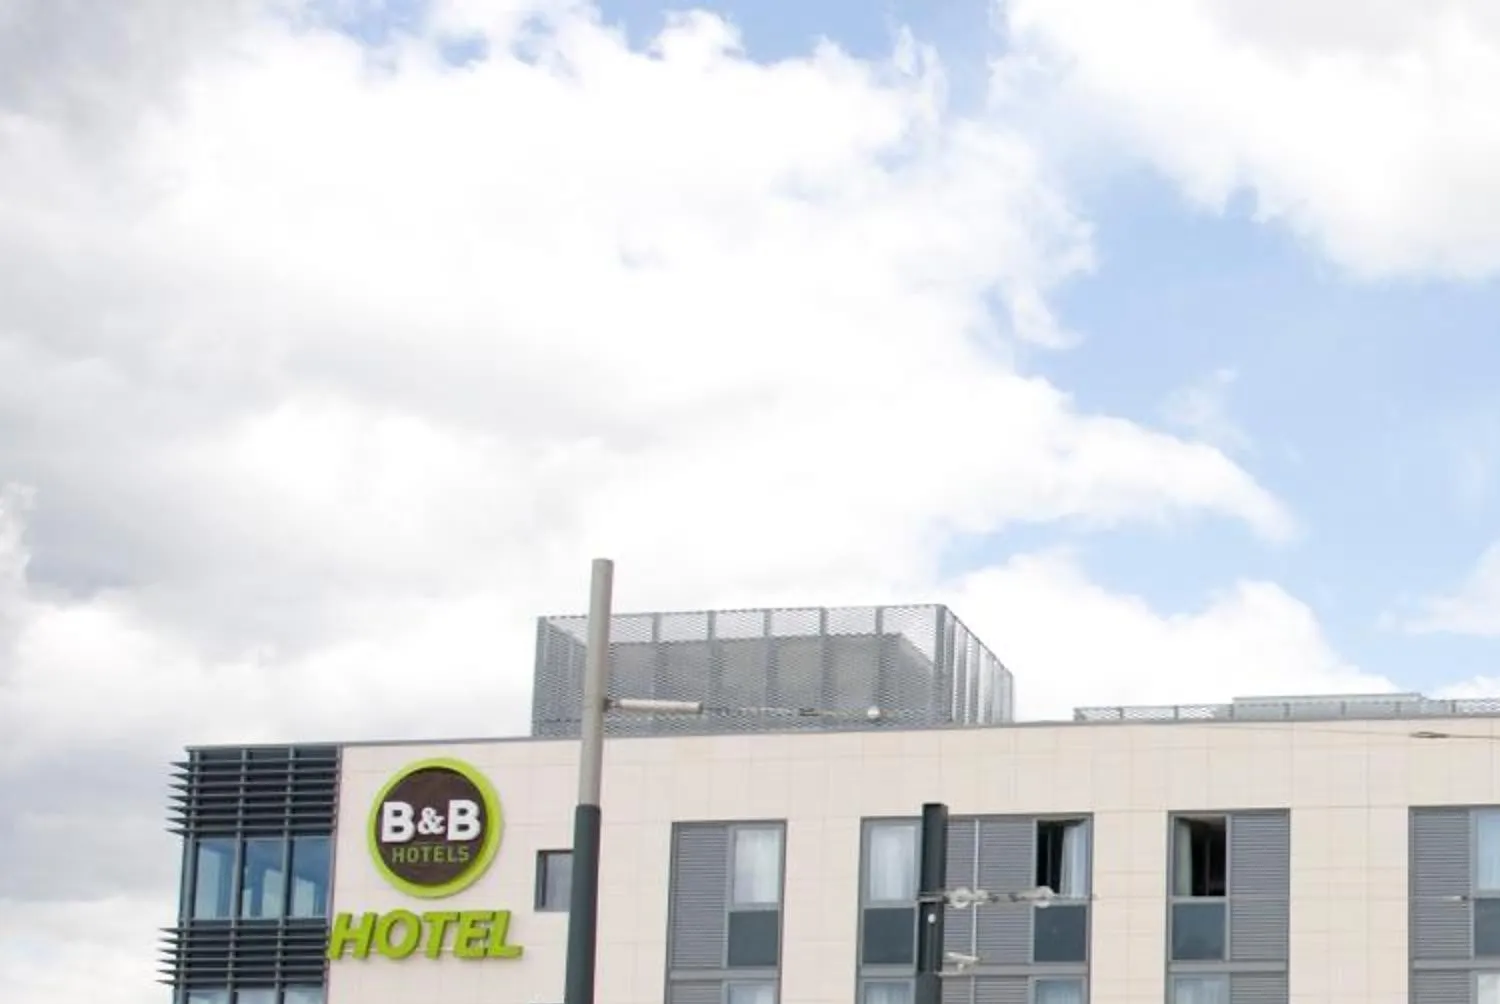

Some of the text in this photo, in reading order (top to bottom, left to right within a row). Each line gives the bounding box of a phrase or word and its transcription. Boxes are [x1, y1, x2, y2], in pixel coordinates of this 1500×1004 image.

[381, 799, 482, 843] B&B
[391, 846, 471, 864] HOTELS
[328, 909, 525, 961] HOTEL
